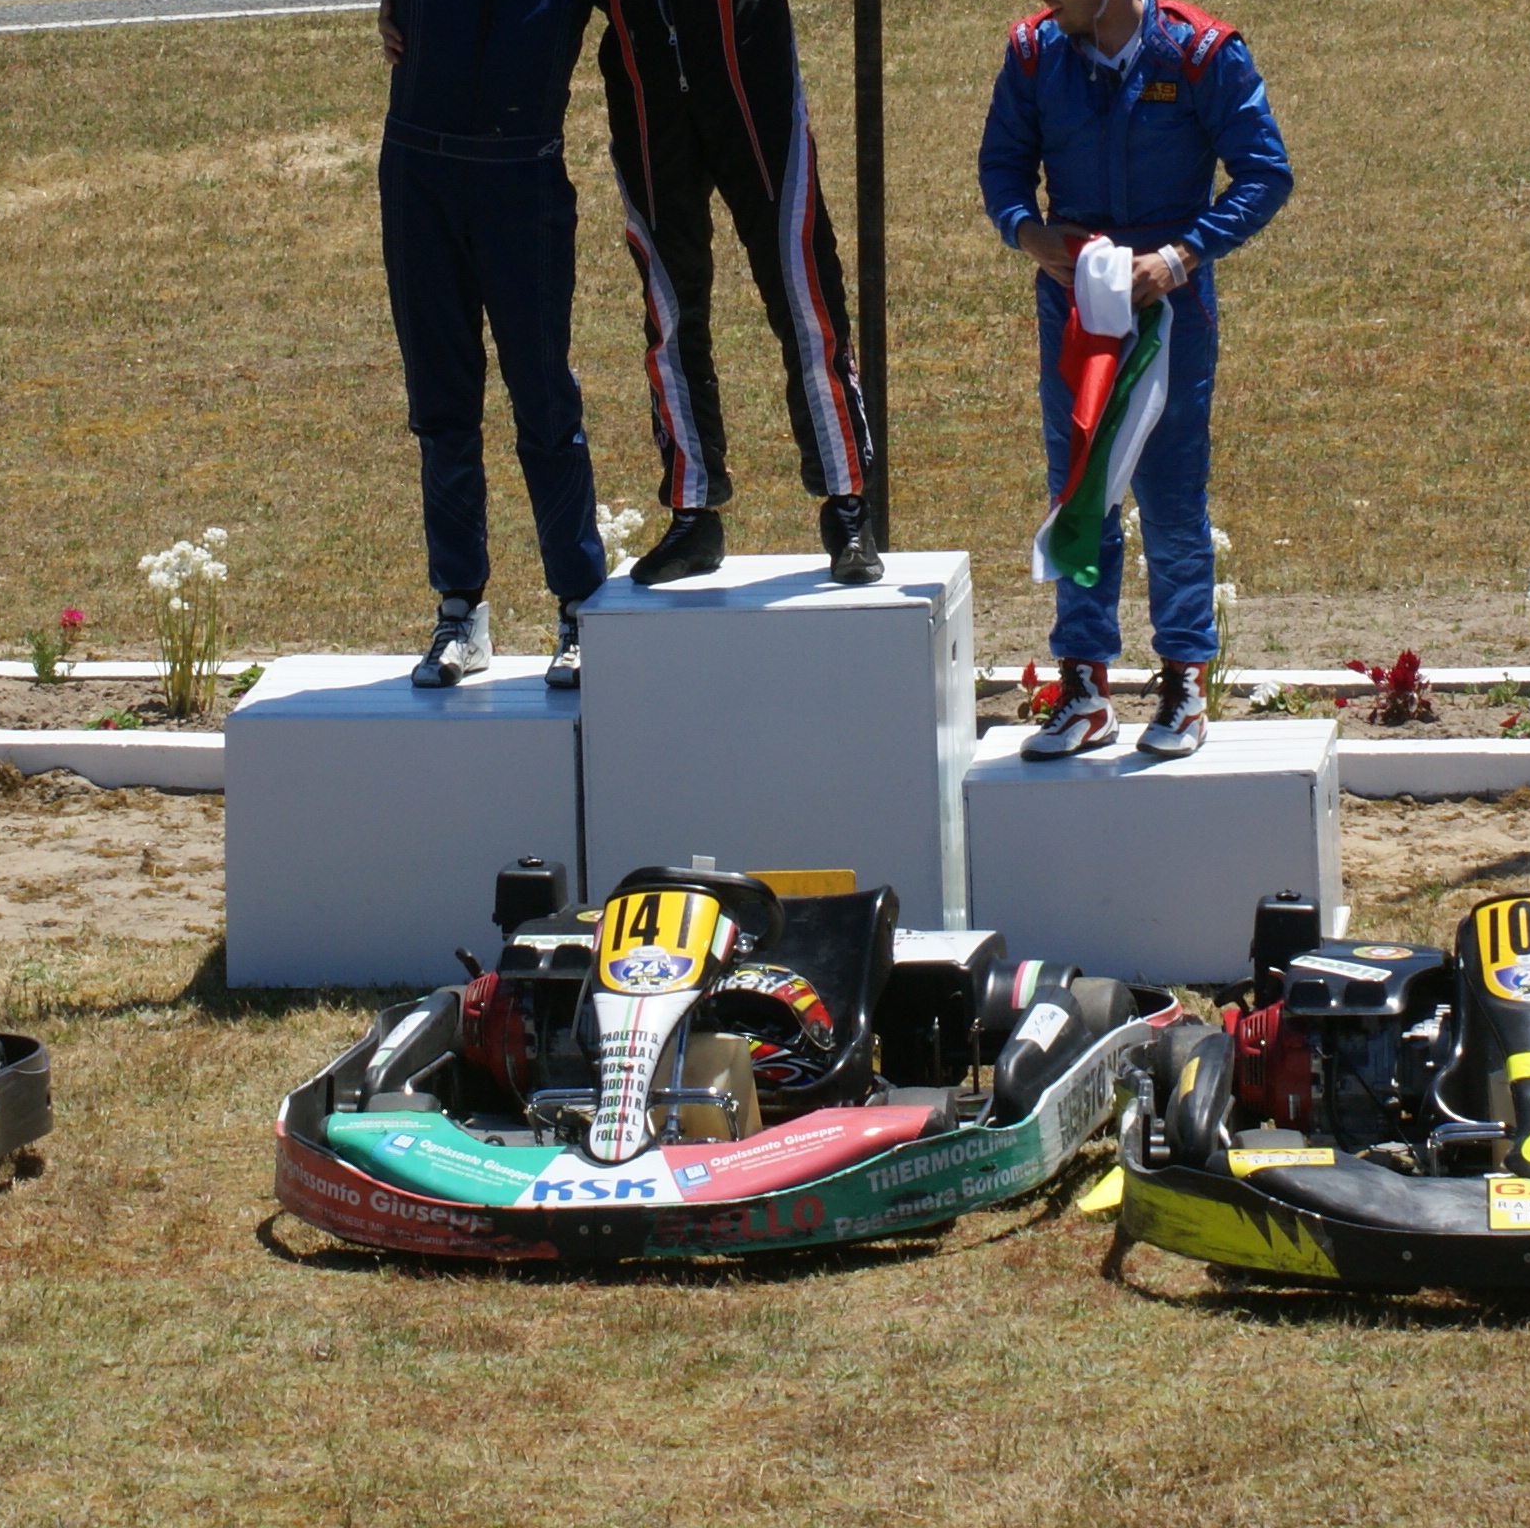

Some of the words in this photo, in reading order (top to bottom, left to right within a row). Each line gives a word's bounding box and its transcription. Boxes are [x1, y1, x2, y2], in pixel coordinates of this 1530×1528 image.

[597, 1112, 629, 1126] ROSIN
[710, 1139, 782, 1167] Ognissanto
[783, 1125, 844, 1147] Giuseppe
[531, 1177, 658, 1202] KSK
